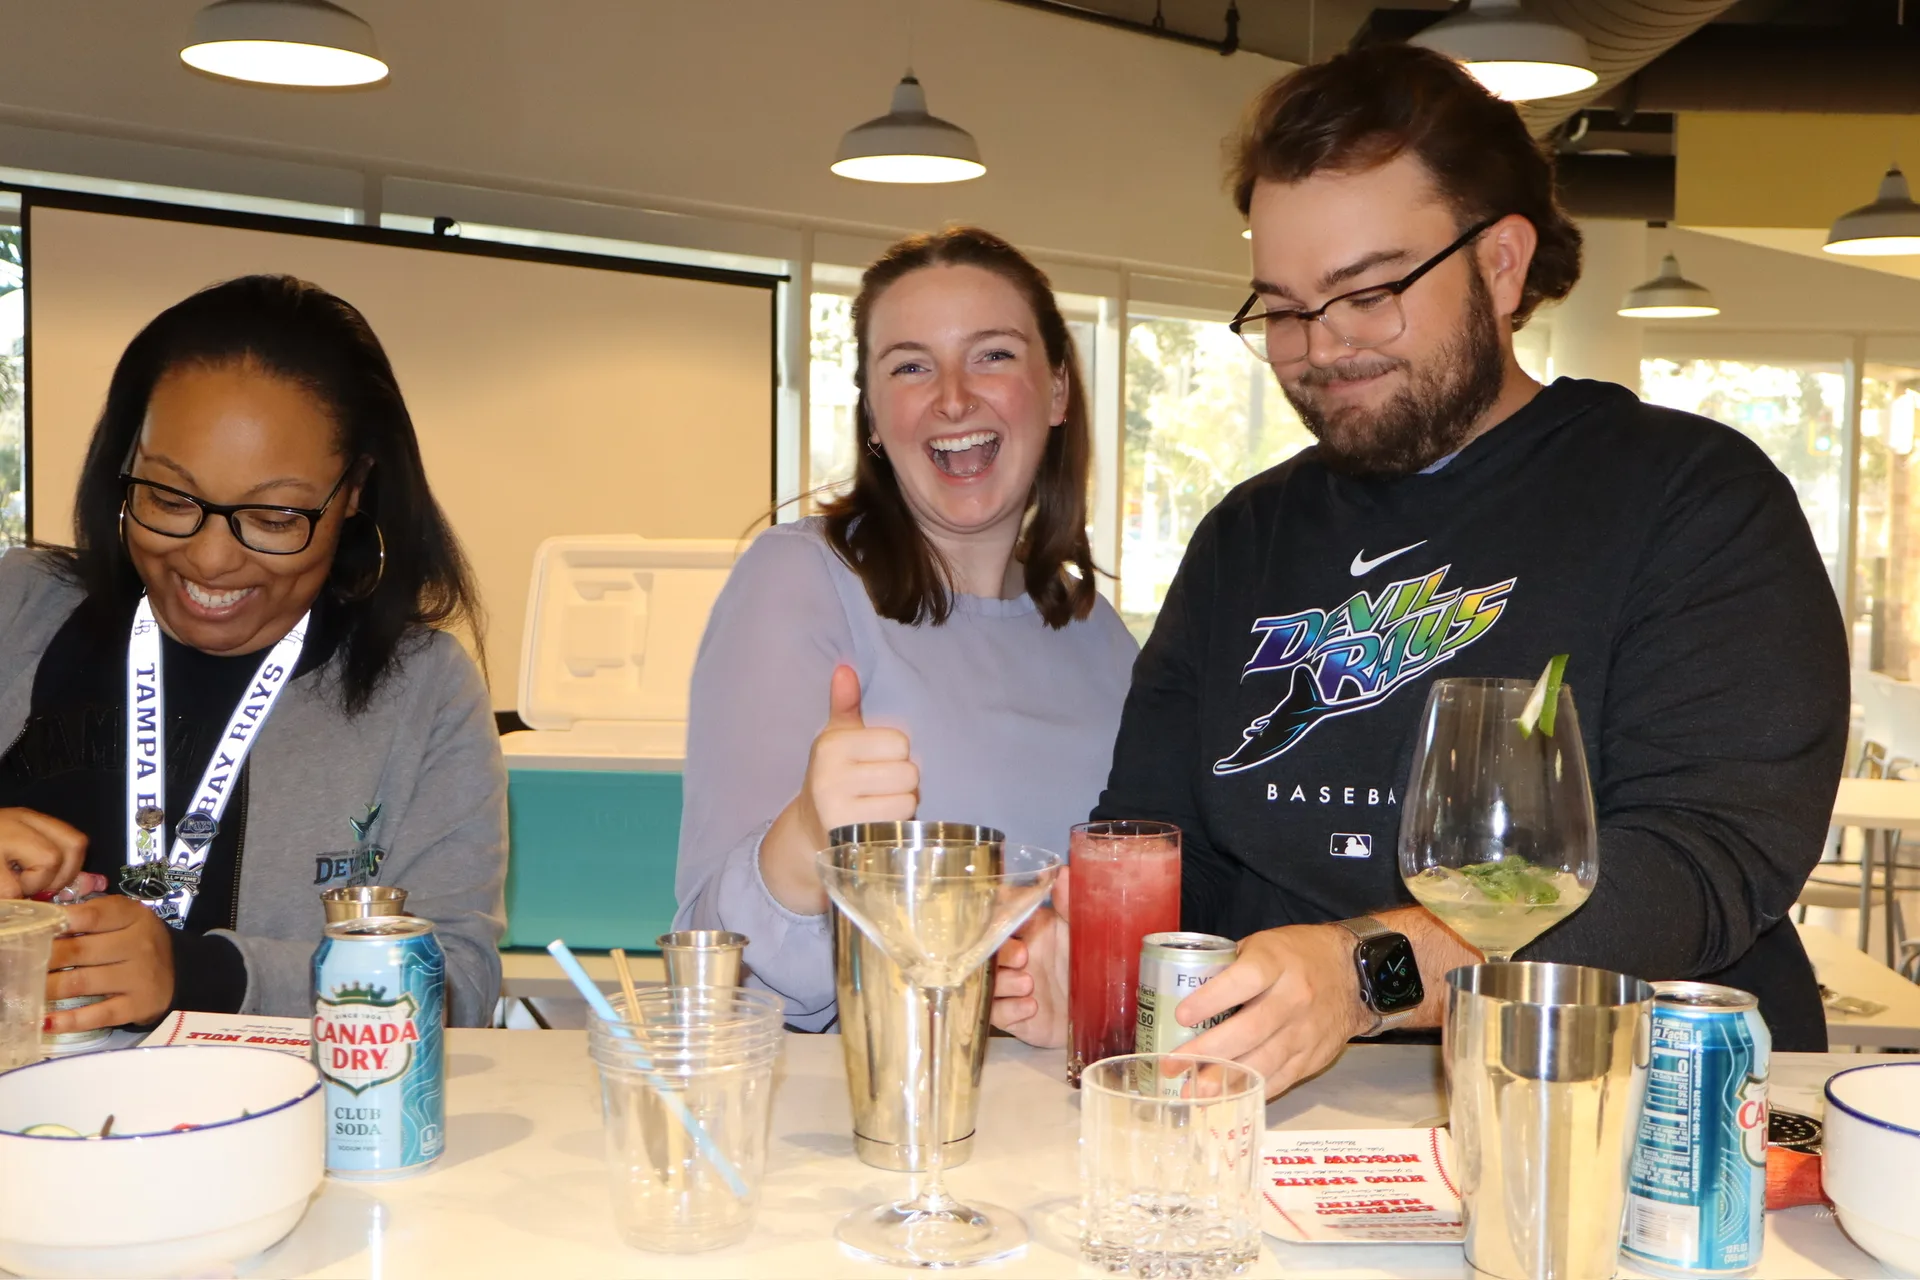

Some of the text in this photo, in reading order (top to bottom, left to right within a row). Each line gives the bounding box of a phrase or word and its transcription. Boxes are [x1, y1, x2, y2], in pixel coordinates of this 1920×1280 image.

[1240, 563, 1462, 685] DEVIL
[1308, 576, 1518, 703] RAYS
[136, 662, 157, 780] TAMPA
[196, 751, 235, 815] BAY
[228, 662, 285, 742] RAYS
[1267, 783, 1397, 805] BASEBA
[1141, 986, 1155, 997] Facts
[1141, 1012, 1154, 1026] 60
[186, 1031, 242, 1042] MULE
[313, 1016, 418, 1045] CANADA
[1662, 1028, 1689, 1041] Facts
[245, 1036, 311, 1047] OSCOW
[332, 1047, 389, 1070] DRY
[1678, 1059, 1688, 1074] 0
[334, 1106, 381, 1120] CLUB
[335, 1122, 382, 1136] SODA
[1263, 1153, 1422, 1165] MOSCOW MUL
[1271, 1175, 1428, 1187] HUGO SPRITZ
[1314, 1198, 1425, 1208] MARTINI
